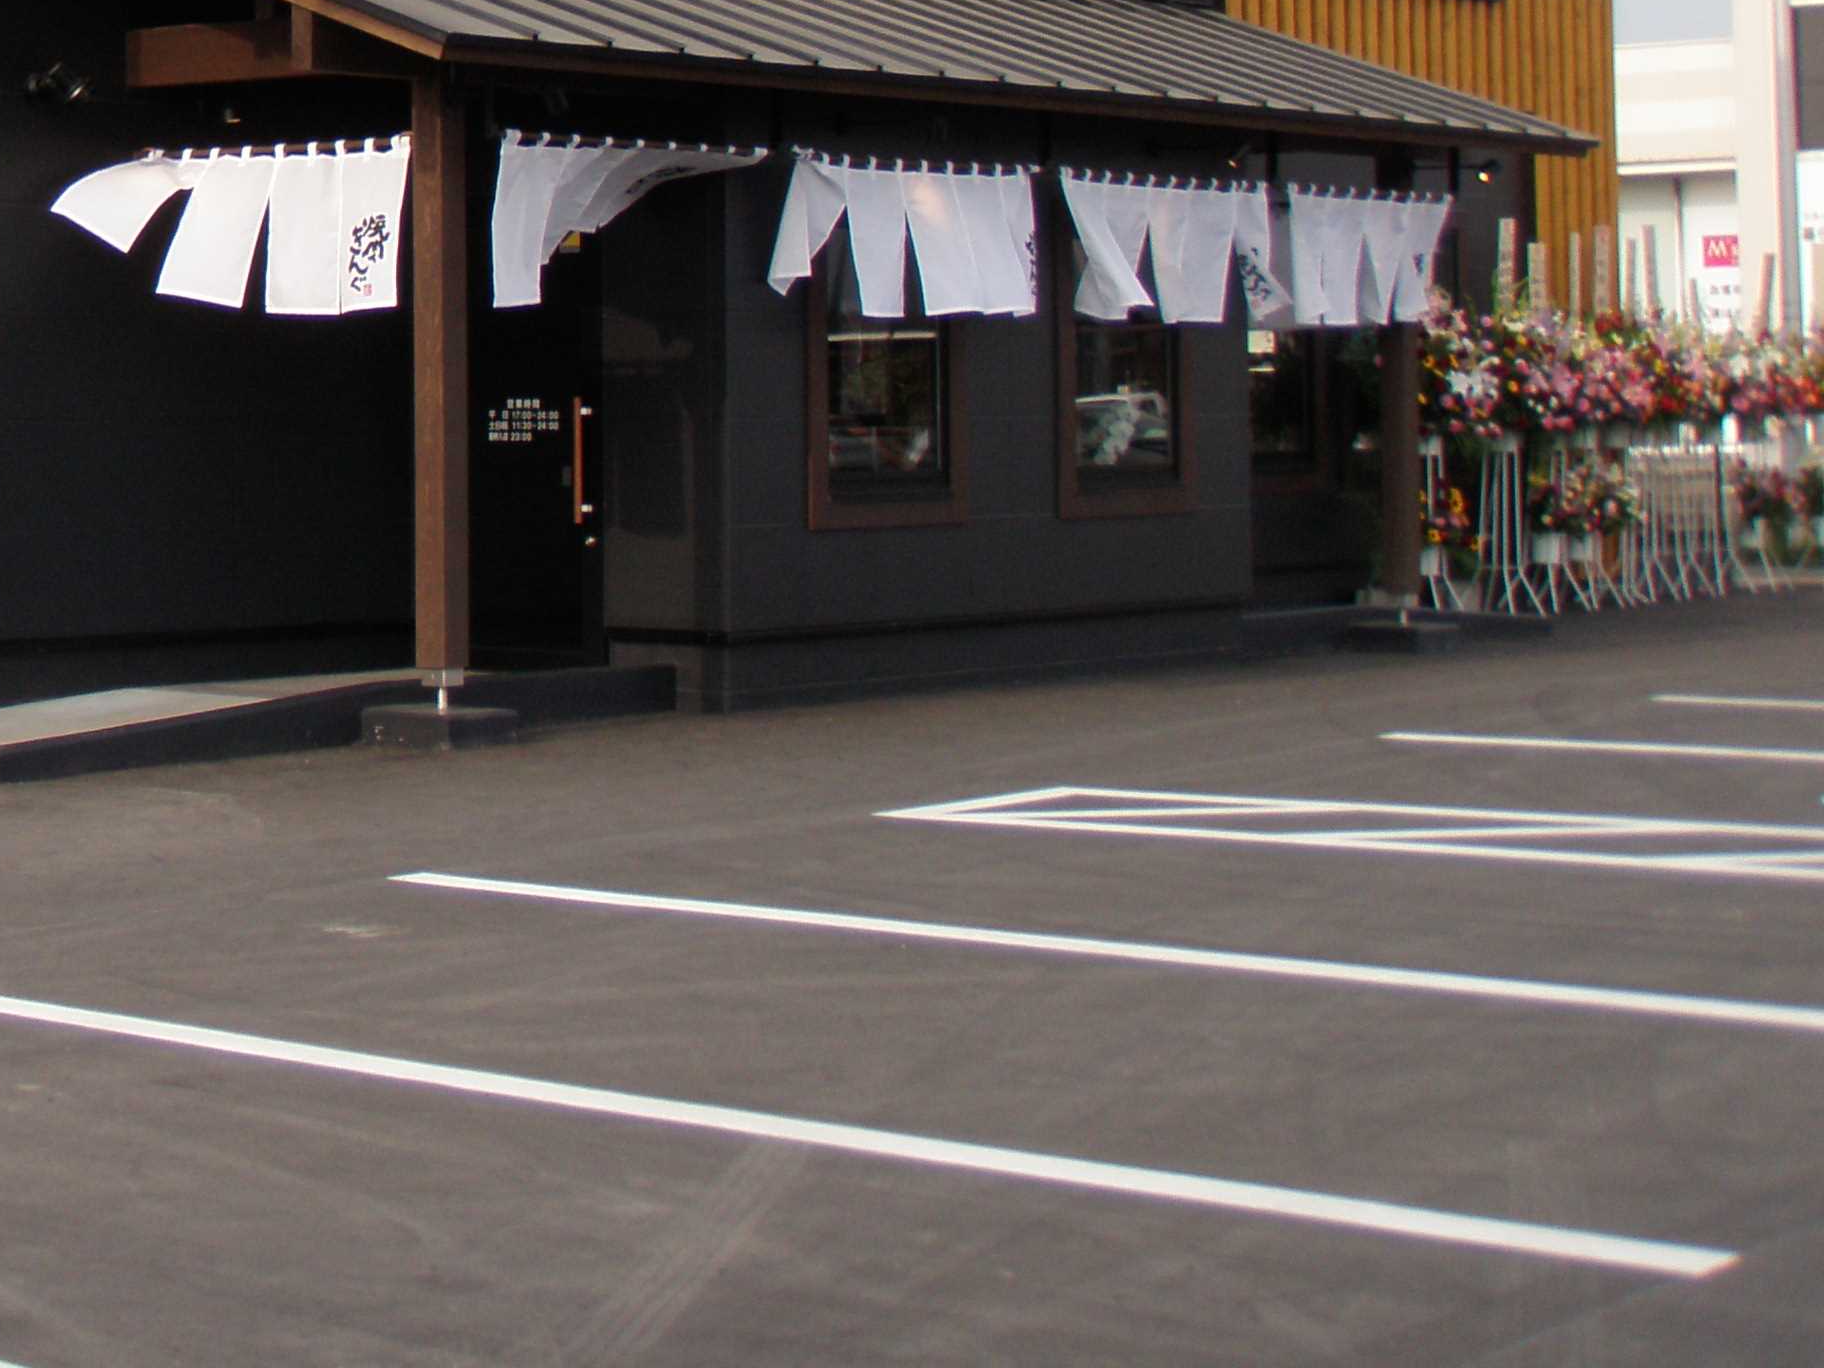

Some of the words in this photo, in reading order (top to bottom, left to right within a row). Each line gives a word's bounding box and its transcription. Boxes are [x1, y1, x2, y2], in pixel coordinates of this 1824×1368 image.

[349, 225, 368, 292] きんぐ
[362, 214, 390, 263] 焼肉
